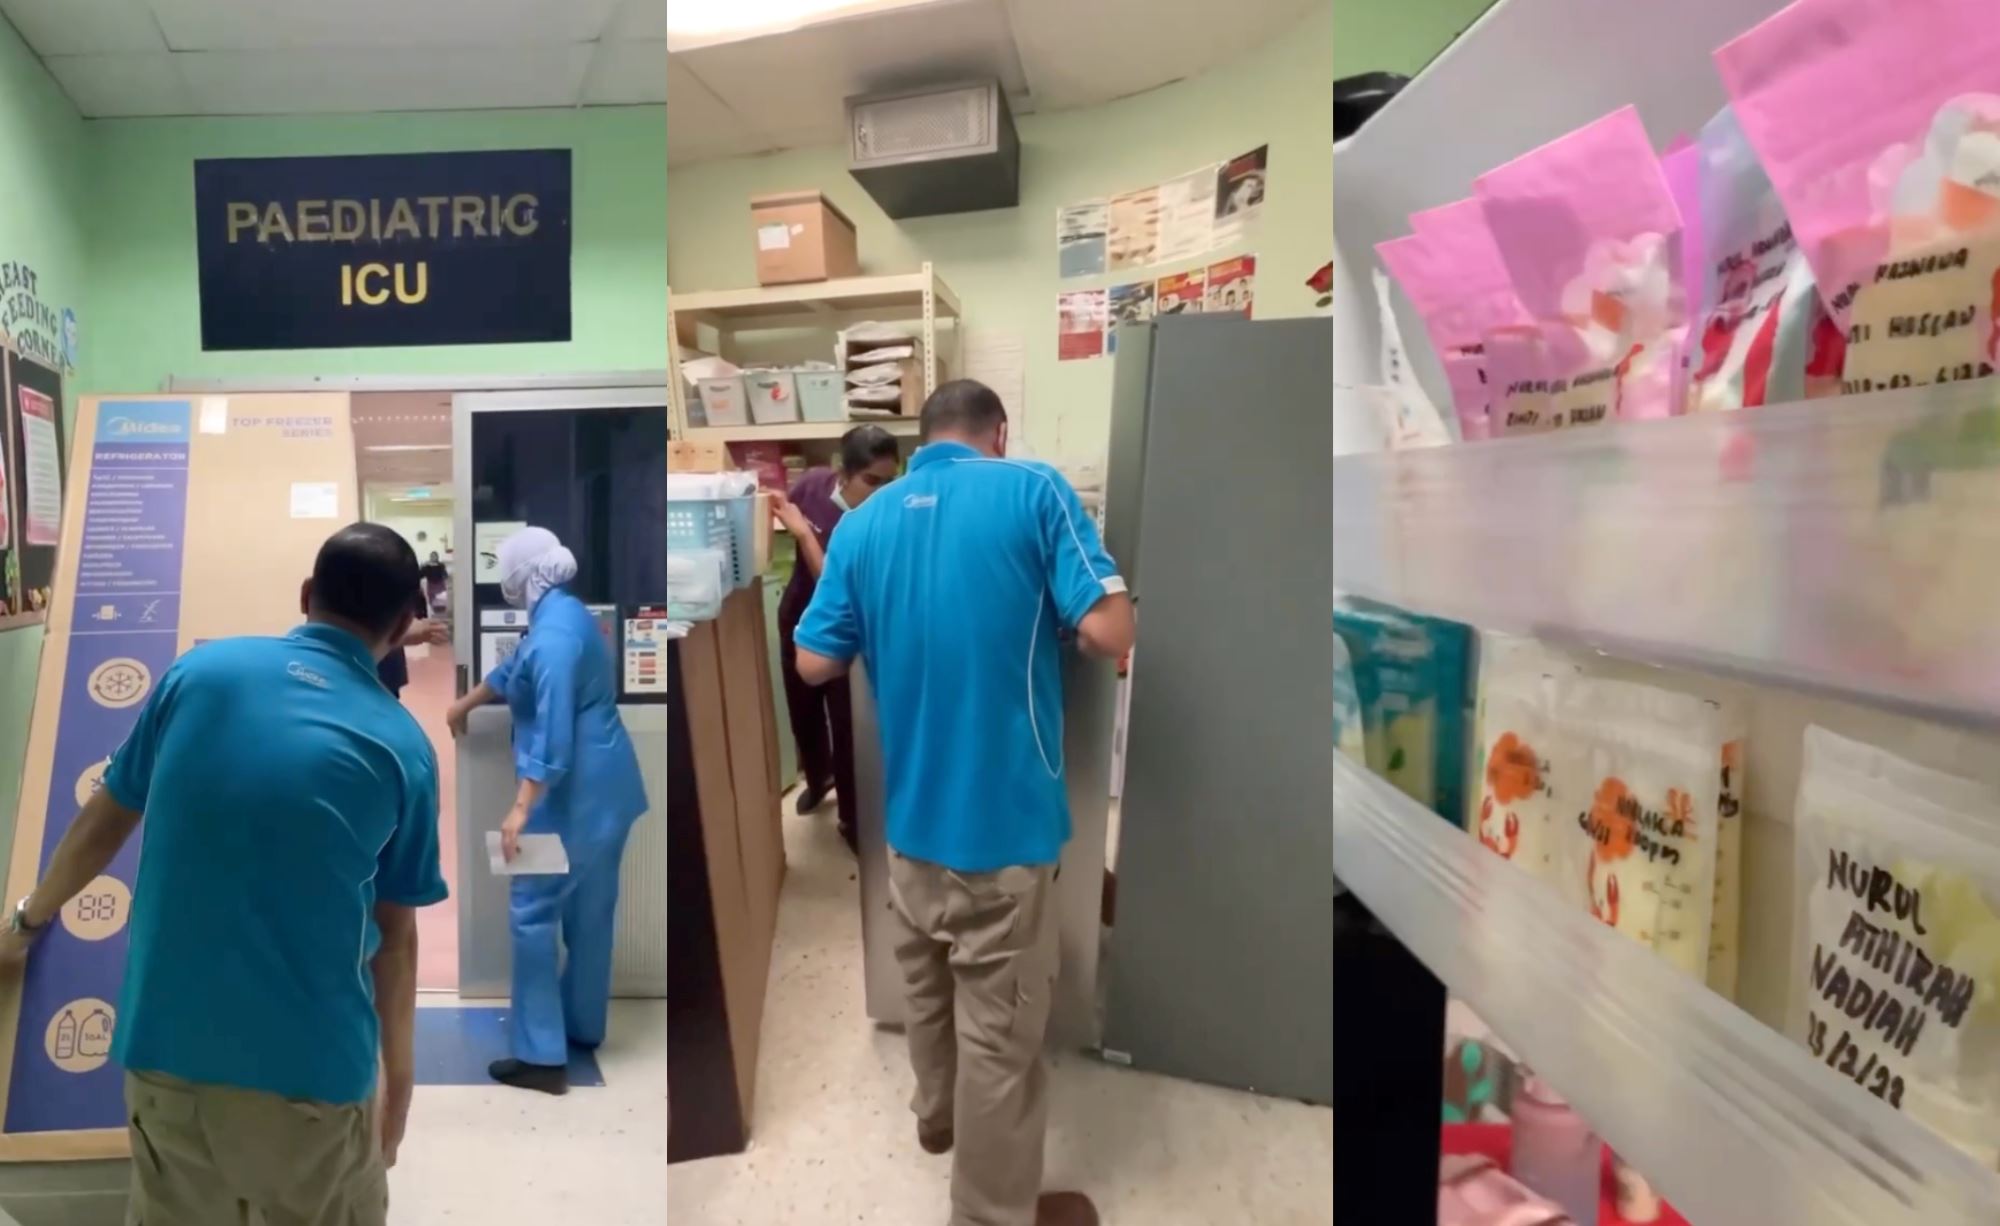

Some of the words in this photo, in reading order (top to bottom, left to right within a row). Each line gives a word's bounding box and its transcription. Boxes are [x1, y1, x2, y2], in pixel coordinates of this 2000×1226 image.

[227, 194, 540, 243] PAEDIATRIC
[0, 260, 37, 296] EAST
[341, 262, 429, 305] ICU
[233, 417, 262, 427] TOP
[266, 416, 332, 426] FREEZER
[281, 428, 333, 438] SERIES
[95, 453, 186, 461] REFRIGERATOR
[1839, 910, 1975, 1028] ATHIRAH
[1810, 943, 1927, 1057] NADIAH
